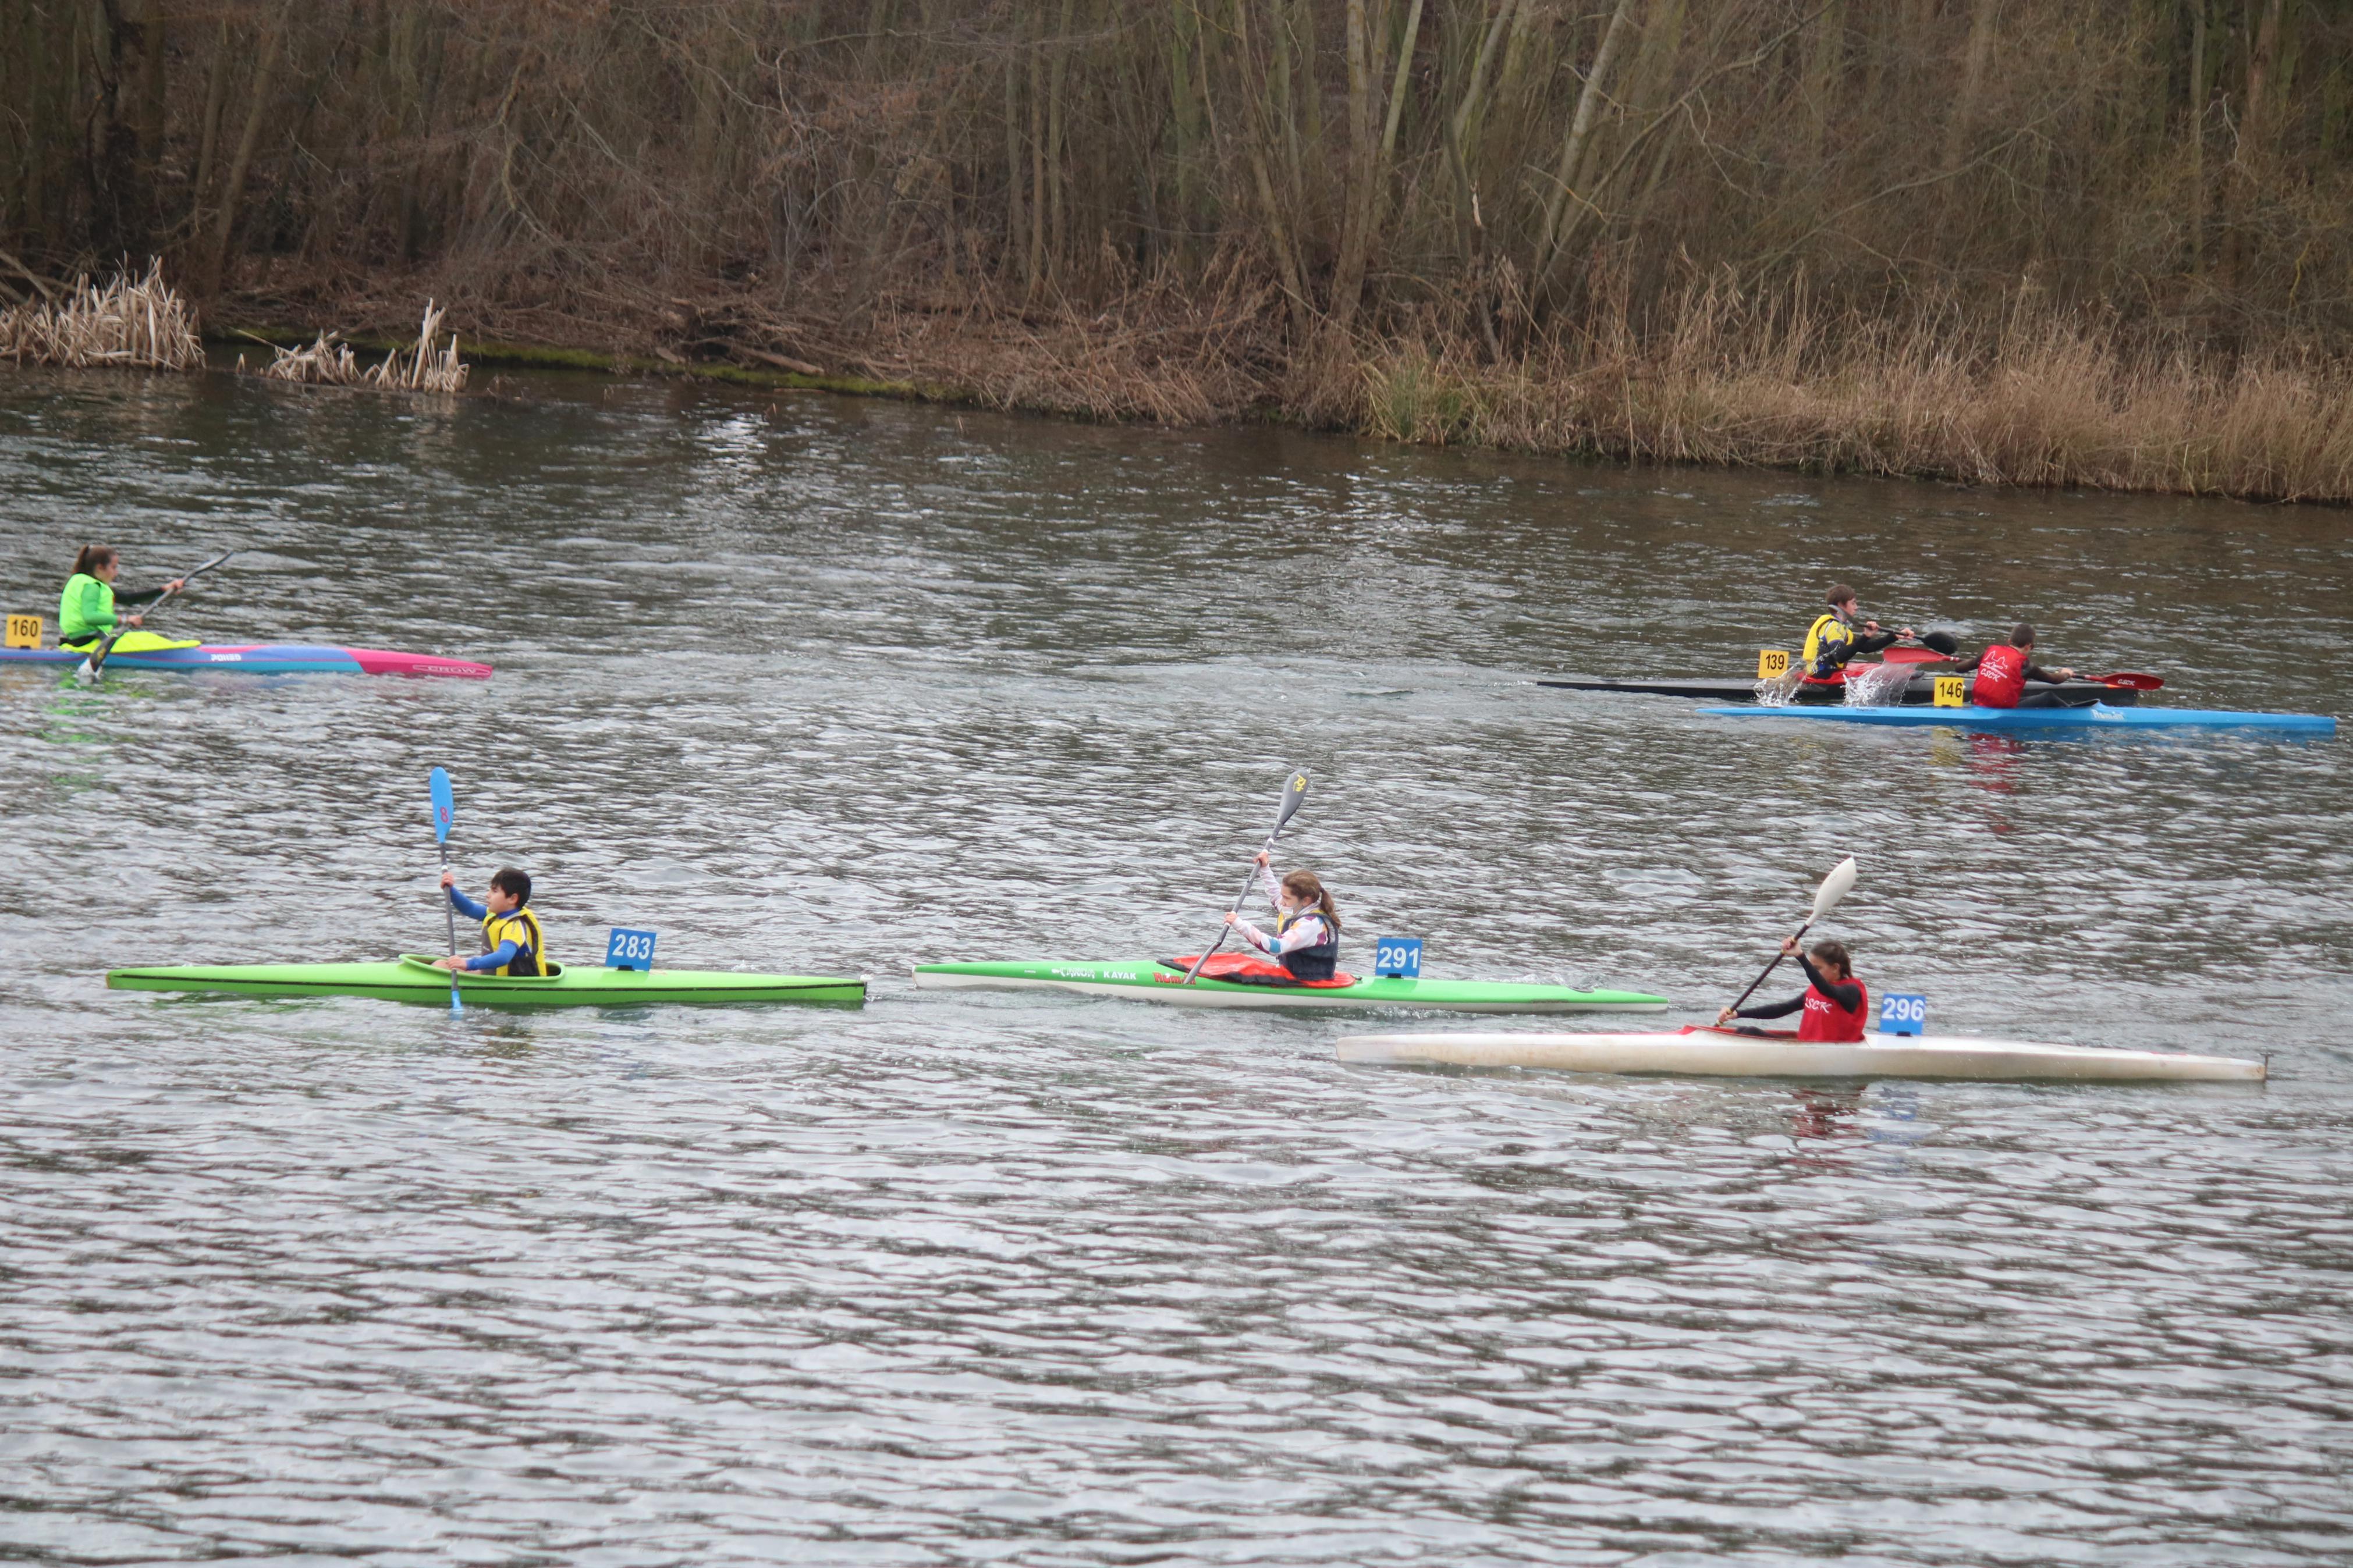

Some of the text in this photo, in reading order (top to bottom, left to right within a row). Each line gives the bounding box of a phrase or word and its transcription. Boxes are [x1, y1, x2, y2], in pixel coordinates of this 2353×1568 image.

[12, 619, 38, 637] 160
[1766, 653, 1784, 670] 139
[1980, 668, 2000, 682] CSCK
[1939, 681, 1962, 698] 146
[439, 806, 449, 823] 8
[612, 934, 651, 959] 283
[1378, 947, 1419, 969] 291
[1103, 970, 1137, 980] KAYAK
[1804, 997, 1833, 1014] SCK
[1881, 997, 1925, 1021] 296
